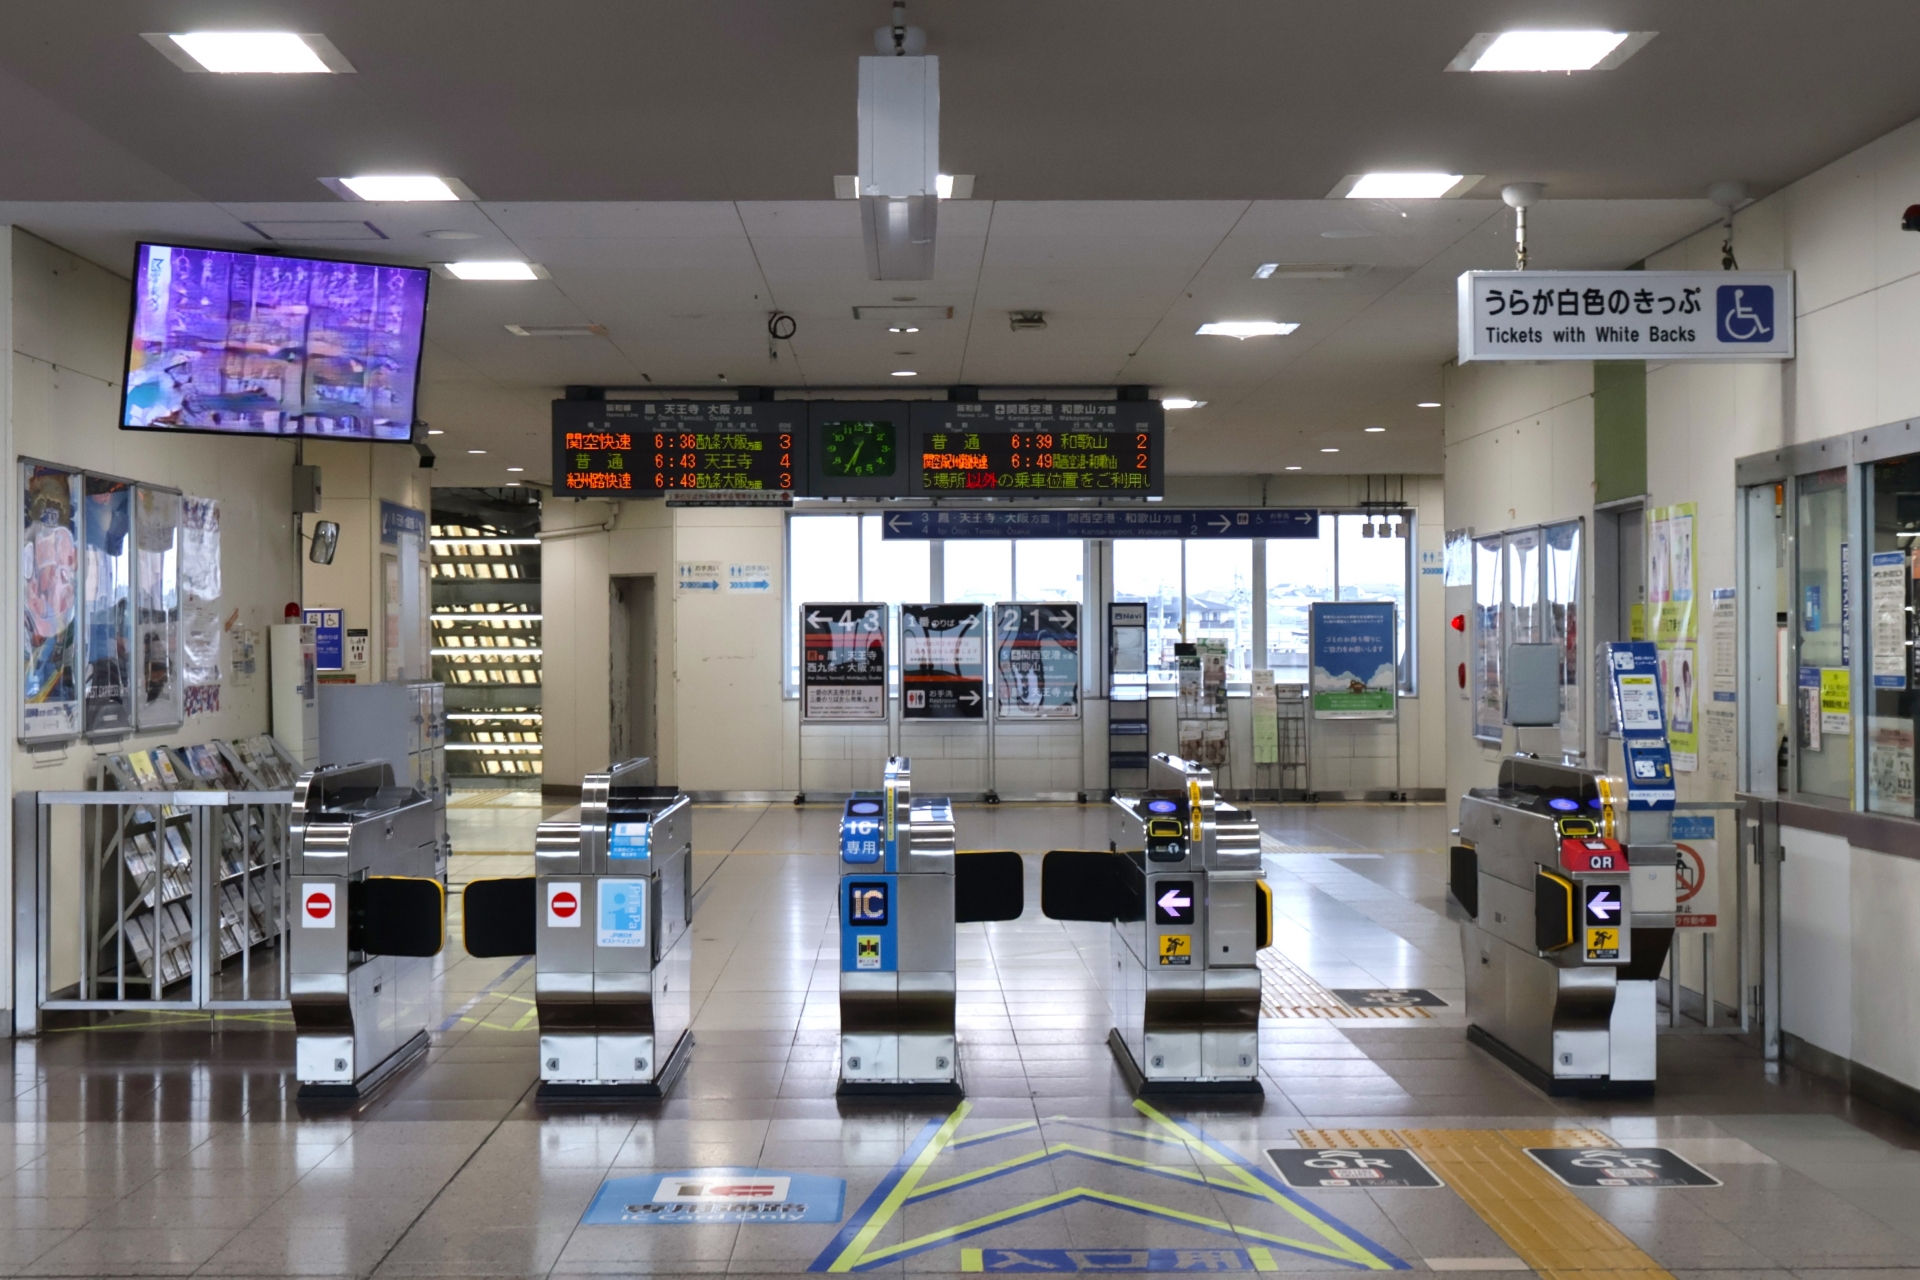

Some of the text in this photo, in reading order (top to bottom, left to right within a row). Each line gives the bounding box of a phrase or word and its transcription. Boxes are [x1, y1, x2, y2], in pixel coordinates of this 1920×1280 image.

[1485, 288, 1701, 316] うらが白色のきっぷ
[1486, 327, 1695, 343] Tickets with White Backs
[566, 433, 632, 450] 関空快速
[780, 434, 791, 449] 3
[932, 433, 980, 450] 普通
[1061, 433, 1108, 450] 和歌山
[1136, 434, 1147, 449] 2
[575, 453, 624, 470] 普通
[704, 453, 753, 469] 天王寺
[780, 453, 791, 468] 4
[1136, 453, 1147, 469] 2
[566, 472, 632, 489] 紀州路快速
[780, 473, 791, 488] 3
[921, 513, 929, 523] 3
[1067, 513, 1197, 524] 関西空港・和歌山方面 1
[921, 525, 929, 534] 4
[1190, 525, 1198, 535] 2
[907, 616, 955, 628] 1番のりば
[929, 690, 954, 698] お手洗
[850, 820, 872, 835] IC
[846, 840, 876, 855] 専用
[1590, 856, 1613, 869] QR
[854, 889, 884, 918] IC
[637, 1060, 643, 1069] 3
[852, 1059, 858, 1068] 3
[938, 1059, 945, 1068] 2
[1155, 1058, 1161, 1066] 2
[1242, 1057, 1247, 1065] 1
[1564, 1055, 1569, 1064] 1
[337, 1061, 343, 1069] 4
[550, 1061, 556, 1069] 4
[1303, 1158, 1393, 1169] QR
[1570, 1158, 1662, 1168] QR
[622, 1213, 804, 1222] IC Card Only
